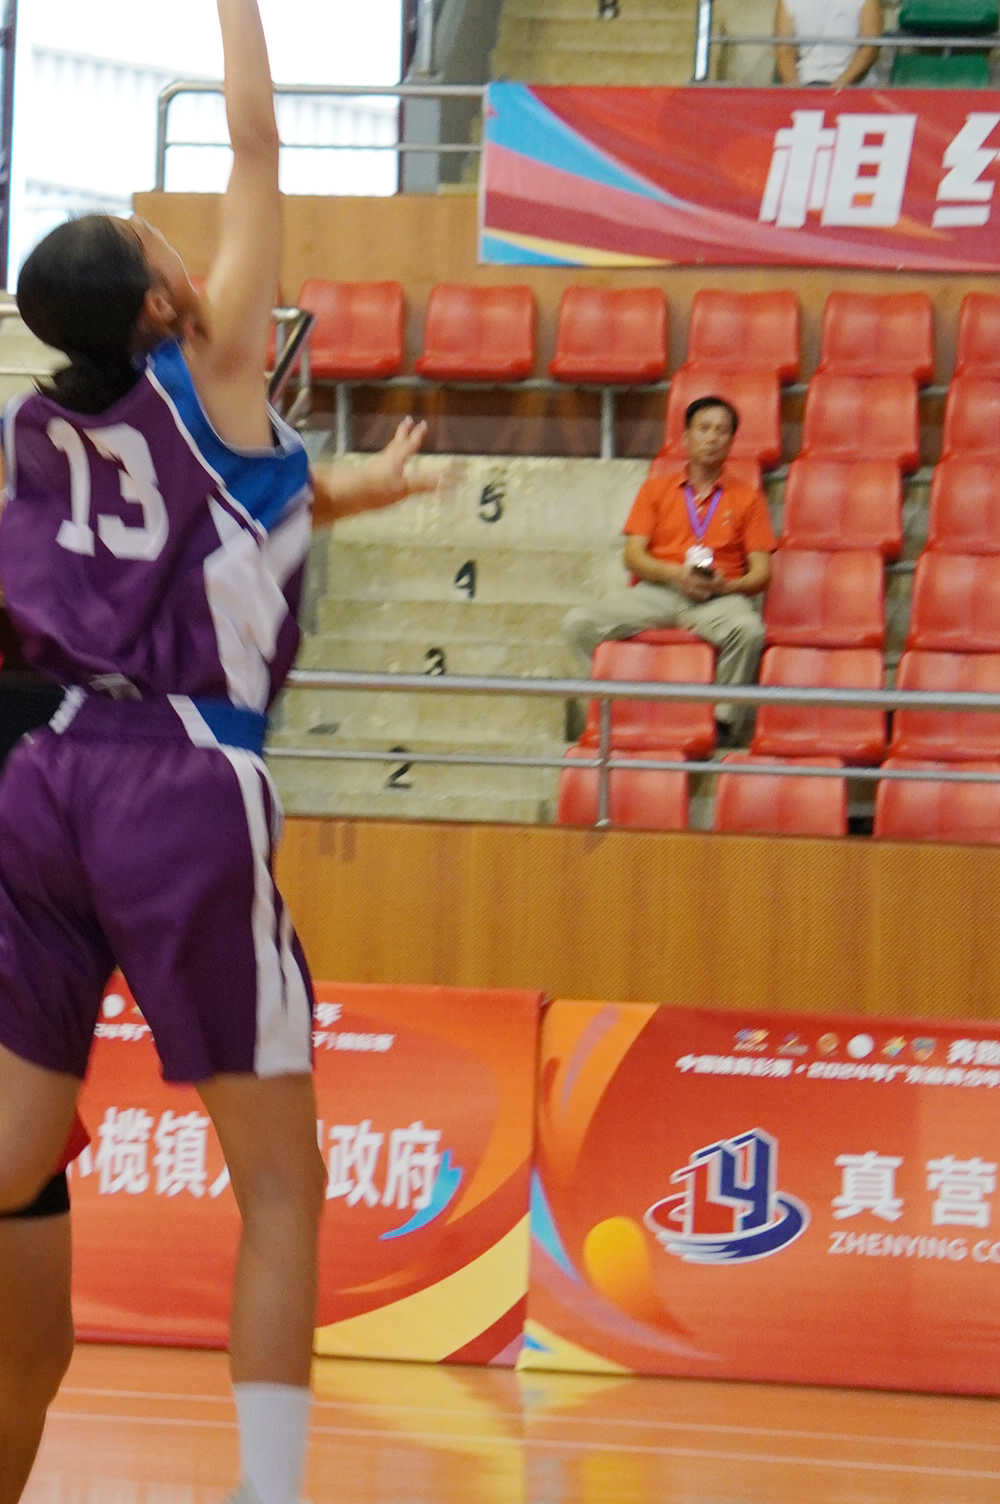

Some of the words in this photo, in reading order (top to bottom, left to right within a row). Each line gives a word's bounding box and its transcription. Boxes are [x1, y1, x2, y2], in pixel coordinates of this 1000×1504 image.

[47, 416, 169, 561] 13
[477, 474, 506, 523] 5
[385, 746, 415, 790] 2
[66, 1105, 442, 1210] 榄镇政府
[831, 1150, 999, 1228] 真营
[827, 1231, 968, 1262] ZHENYING
